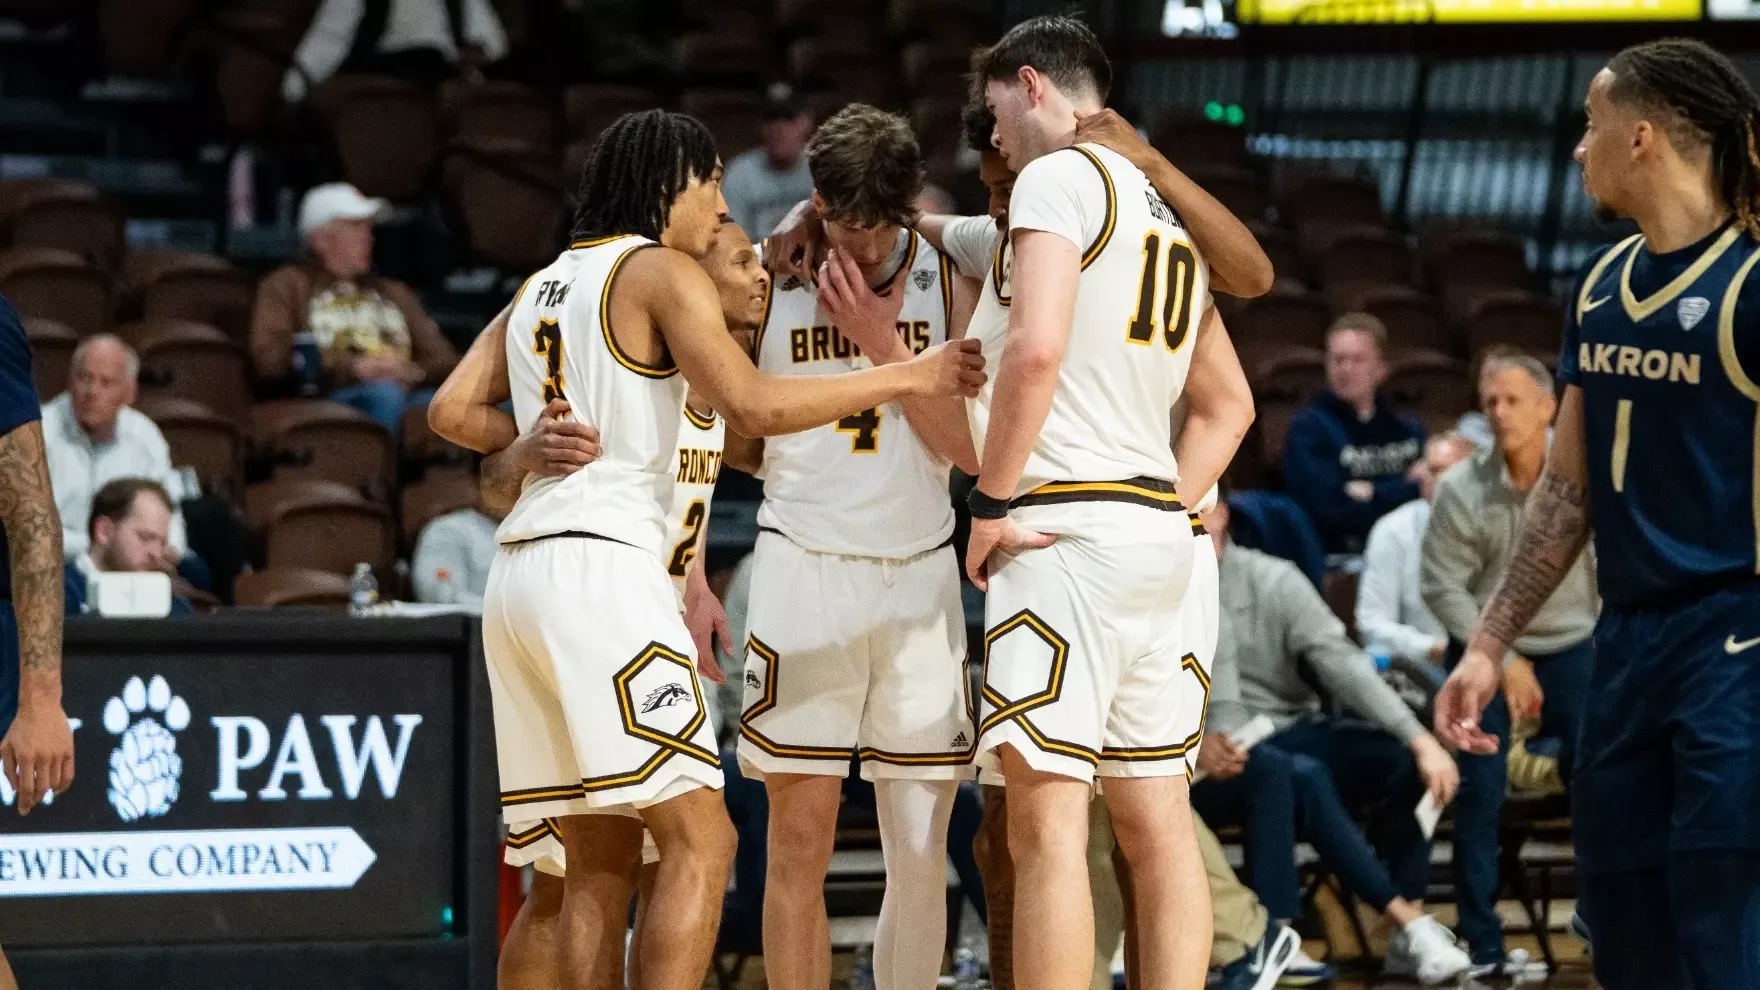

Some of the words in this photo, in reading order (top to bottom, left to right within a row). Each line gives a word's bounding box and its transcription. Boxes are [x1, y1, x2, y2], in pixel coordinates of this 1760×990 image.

[1126, 229, 1198, 354] 10
[532, 316, 567, 405] 3
[790, 320, 930, 363] BROOS
[1578, 342, 1701, 385] AKRON
[1610, 399, 1633, 493] 1
[666, 497, 705, 579] 2
[209, 713, 423, 801] PAW
[0, 845, 130, 881] EWING
[149, 841, 339, 877] COMPANY
